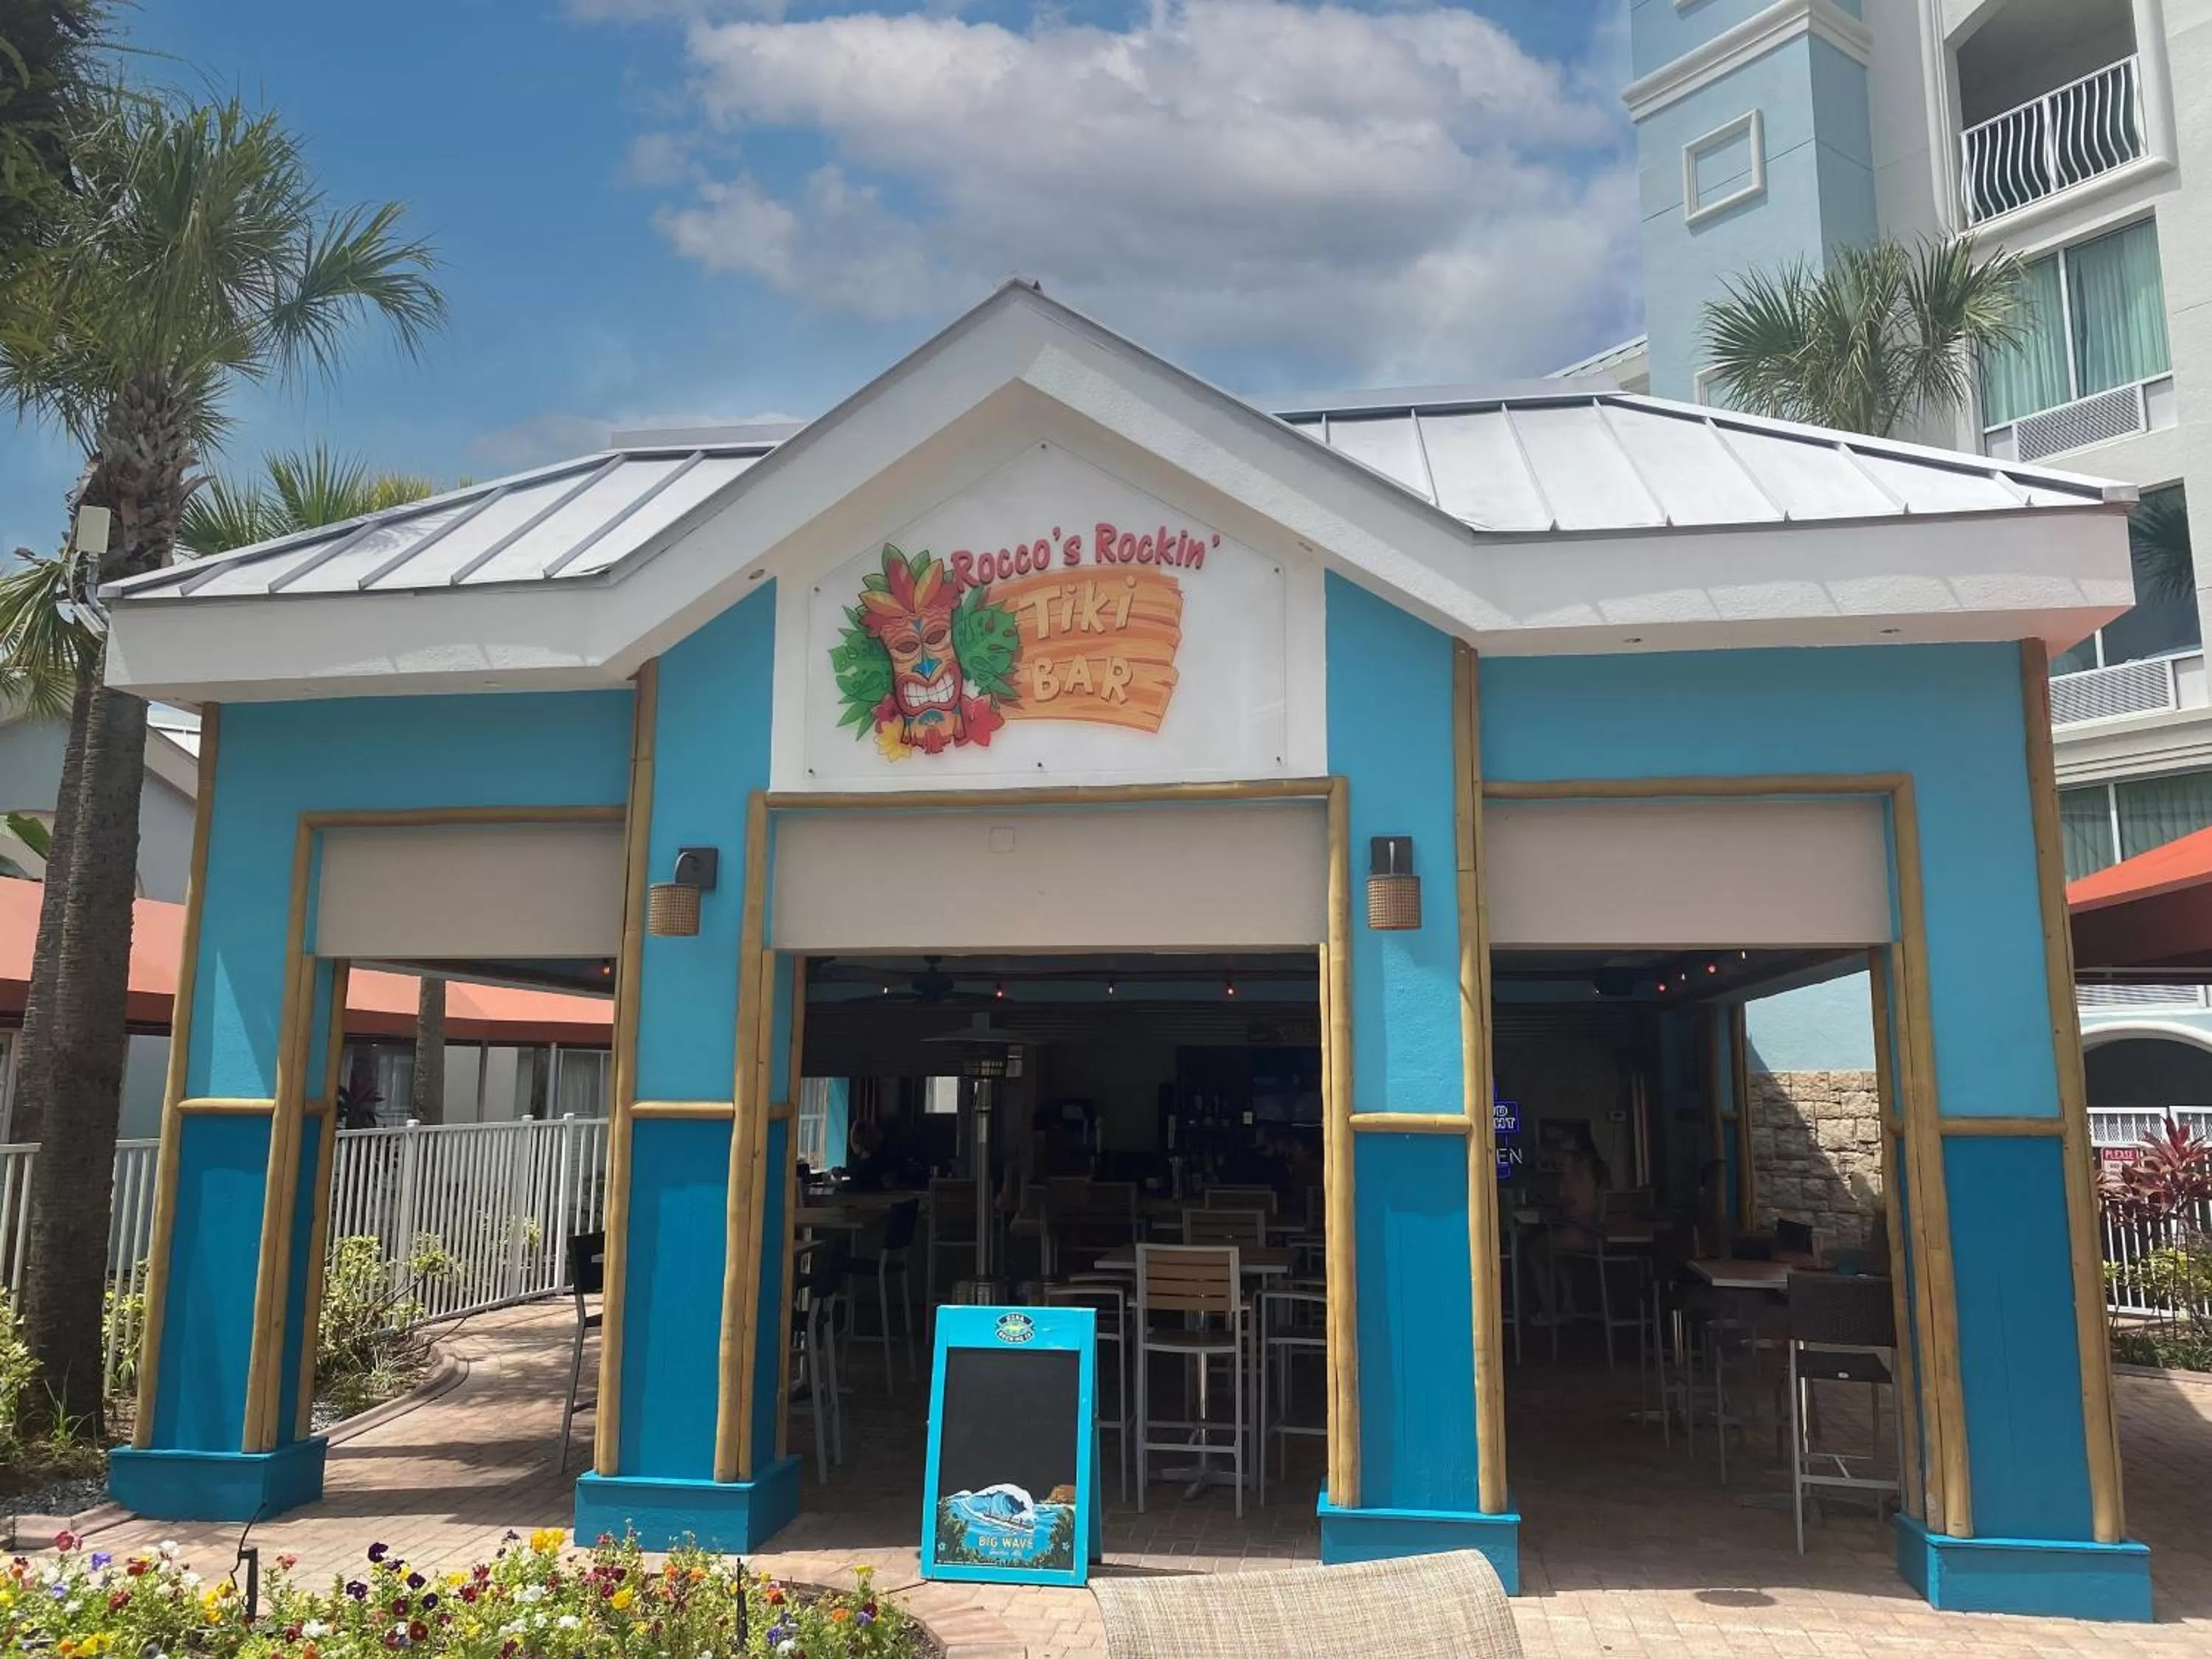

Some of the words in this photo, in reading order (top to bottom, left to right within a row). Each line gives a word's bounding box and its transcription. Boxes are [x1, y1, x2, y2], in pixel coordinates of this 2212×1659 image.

[1095, 523, 1220, 570] Rockin'
[1032, 654, 1133, 705] BAR
[1496, 1147, 1523, 1164] EN
[2105, 1150, 2134, 1160] PLEASE
[978, 1536, 998, 1548] BIG
[1002, 1537, 1034, 1549] WAVE
